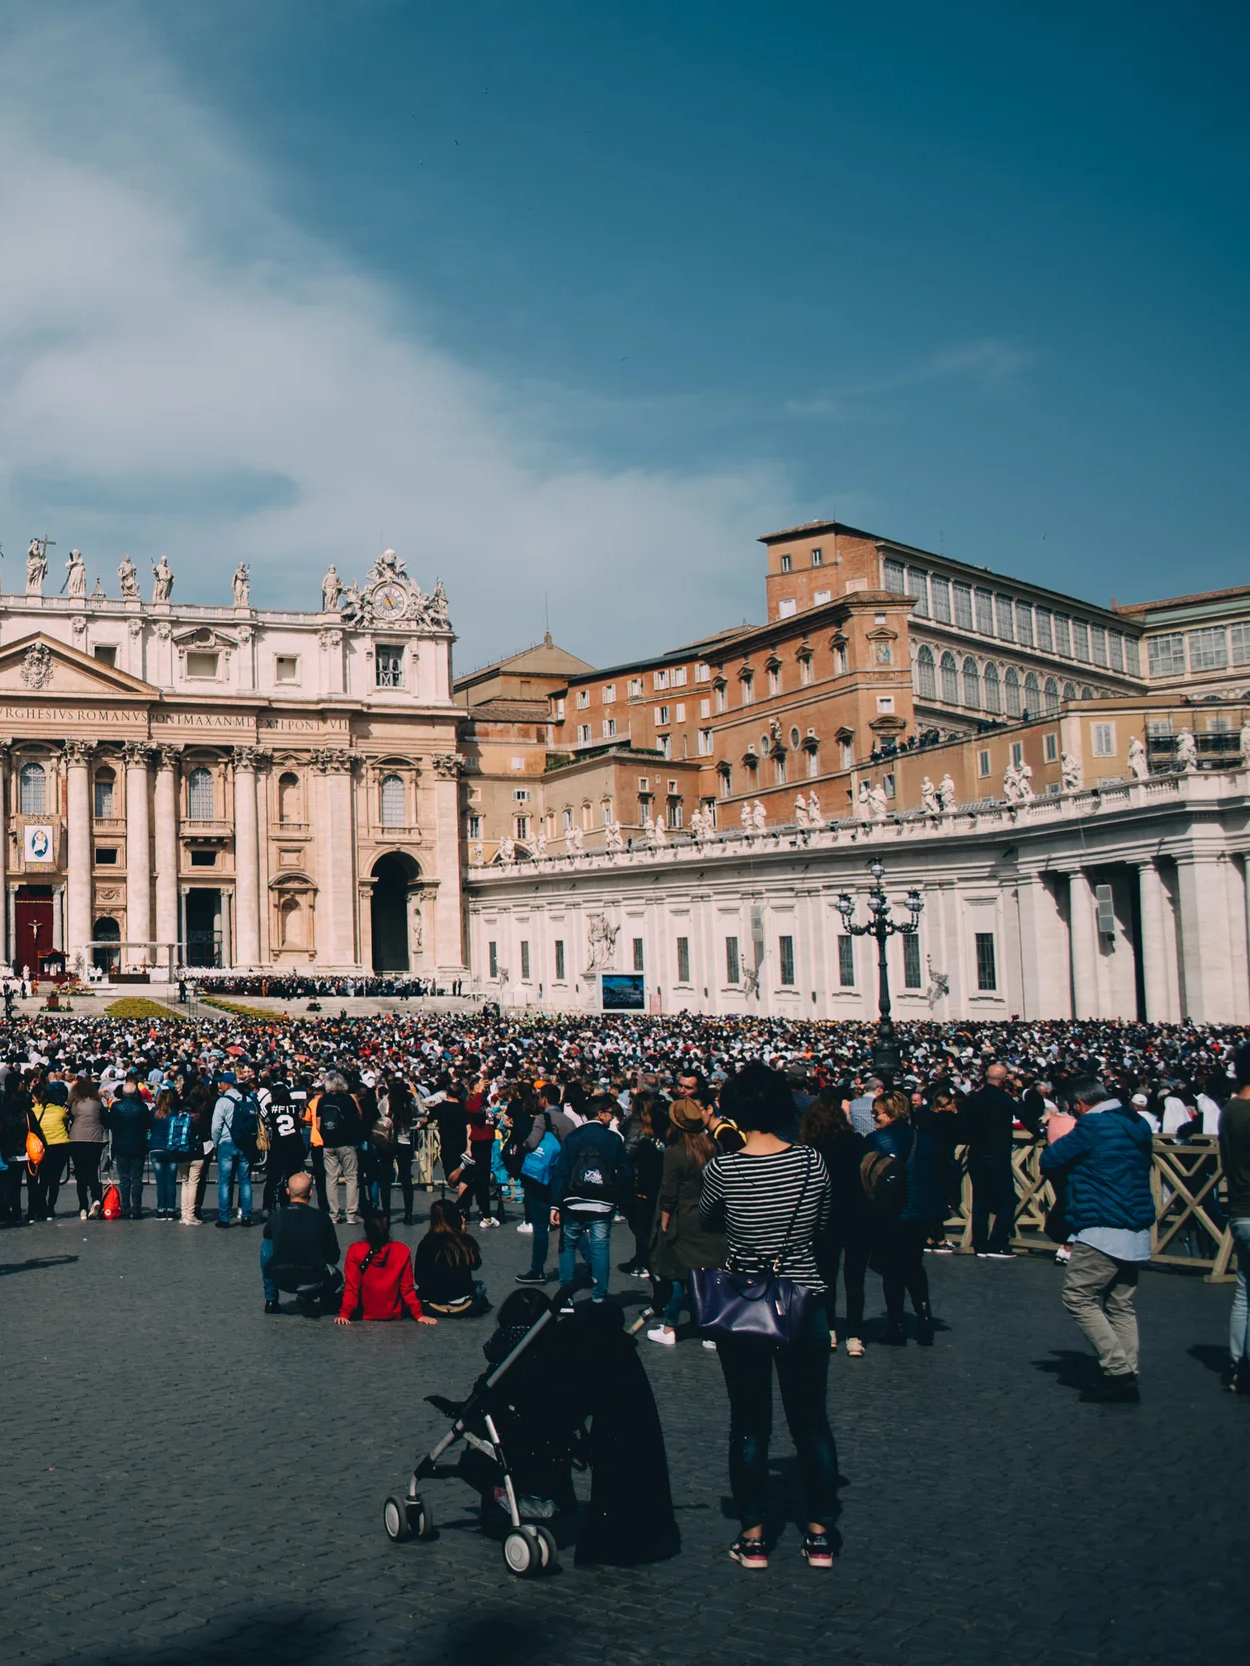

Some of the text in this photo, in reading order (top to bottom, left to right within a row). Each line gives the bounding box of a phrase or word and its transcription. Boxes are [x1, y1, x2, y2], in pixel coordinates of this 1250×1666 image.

[77, 710, 147, 722] ROMANVS
[288, 720, 321, 731] PONT
[329, 719, 348, 731] VII
[271, 1104, 297, 1114] #FIT
[276, 1114, 296, 1137] 2
